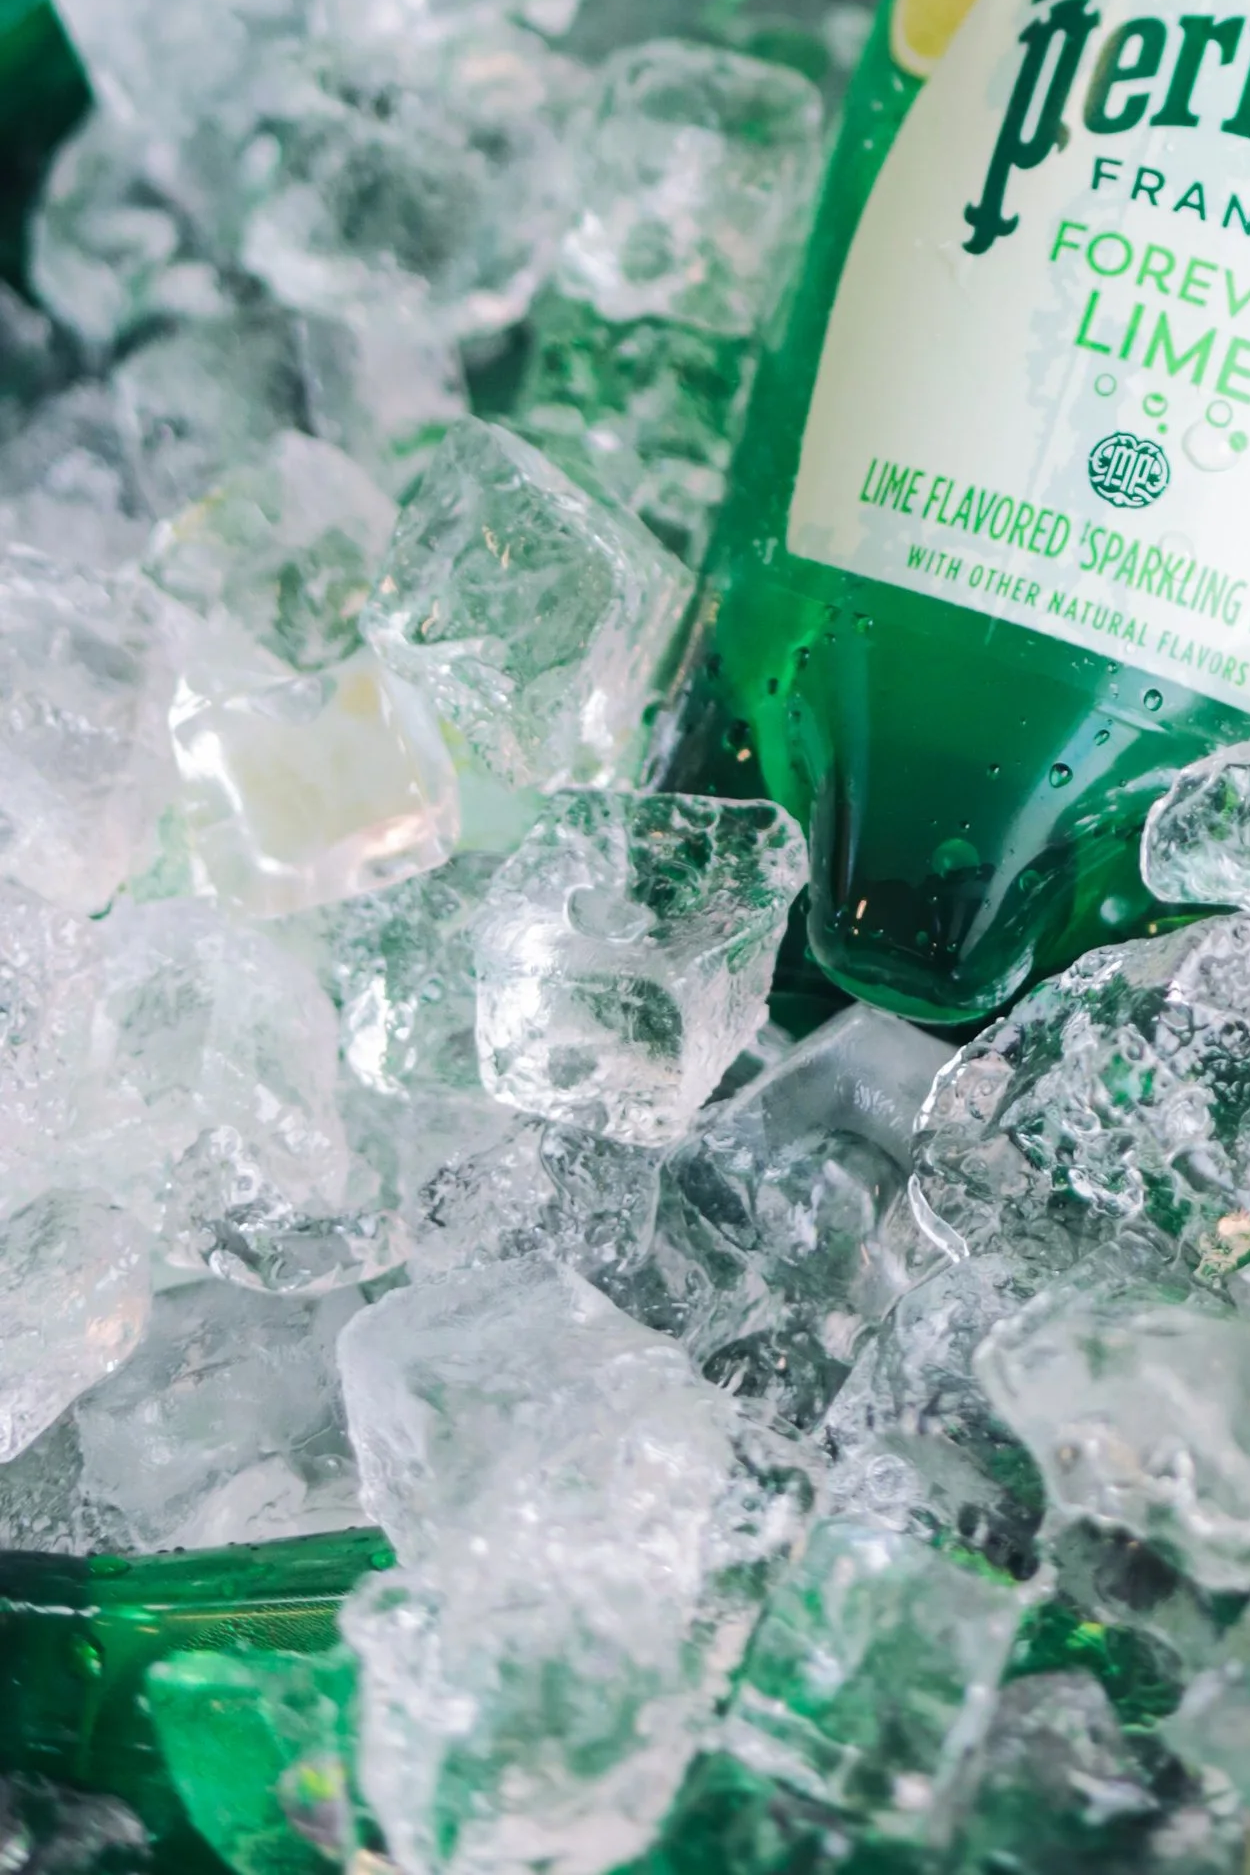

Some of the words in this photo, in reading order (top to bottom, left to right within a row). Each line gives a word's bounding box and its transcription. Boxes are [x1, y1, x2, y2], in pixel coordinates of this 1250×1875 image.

[859, 457, 925, 515] LIME
[922, 474, 1072, 558] FLAVORED
[1078, 524, 1249, 627] SPARKLING
[906, 543, 963, 581] WITH
[968, 564, 1042, 608] OTHER
[1046, 589, 1149, 648] NATURAL
[1156, 630, 1250, 687] FLAVORS
